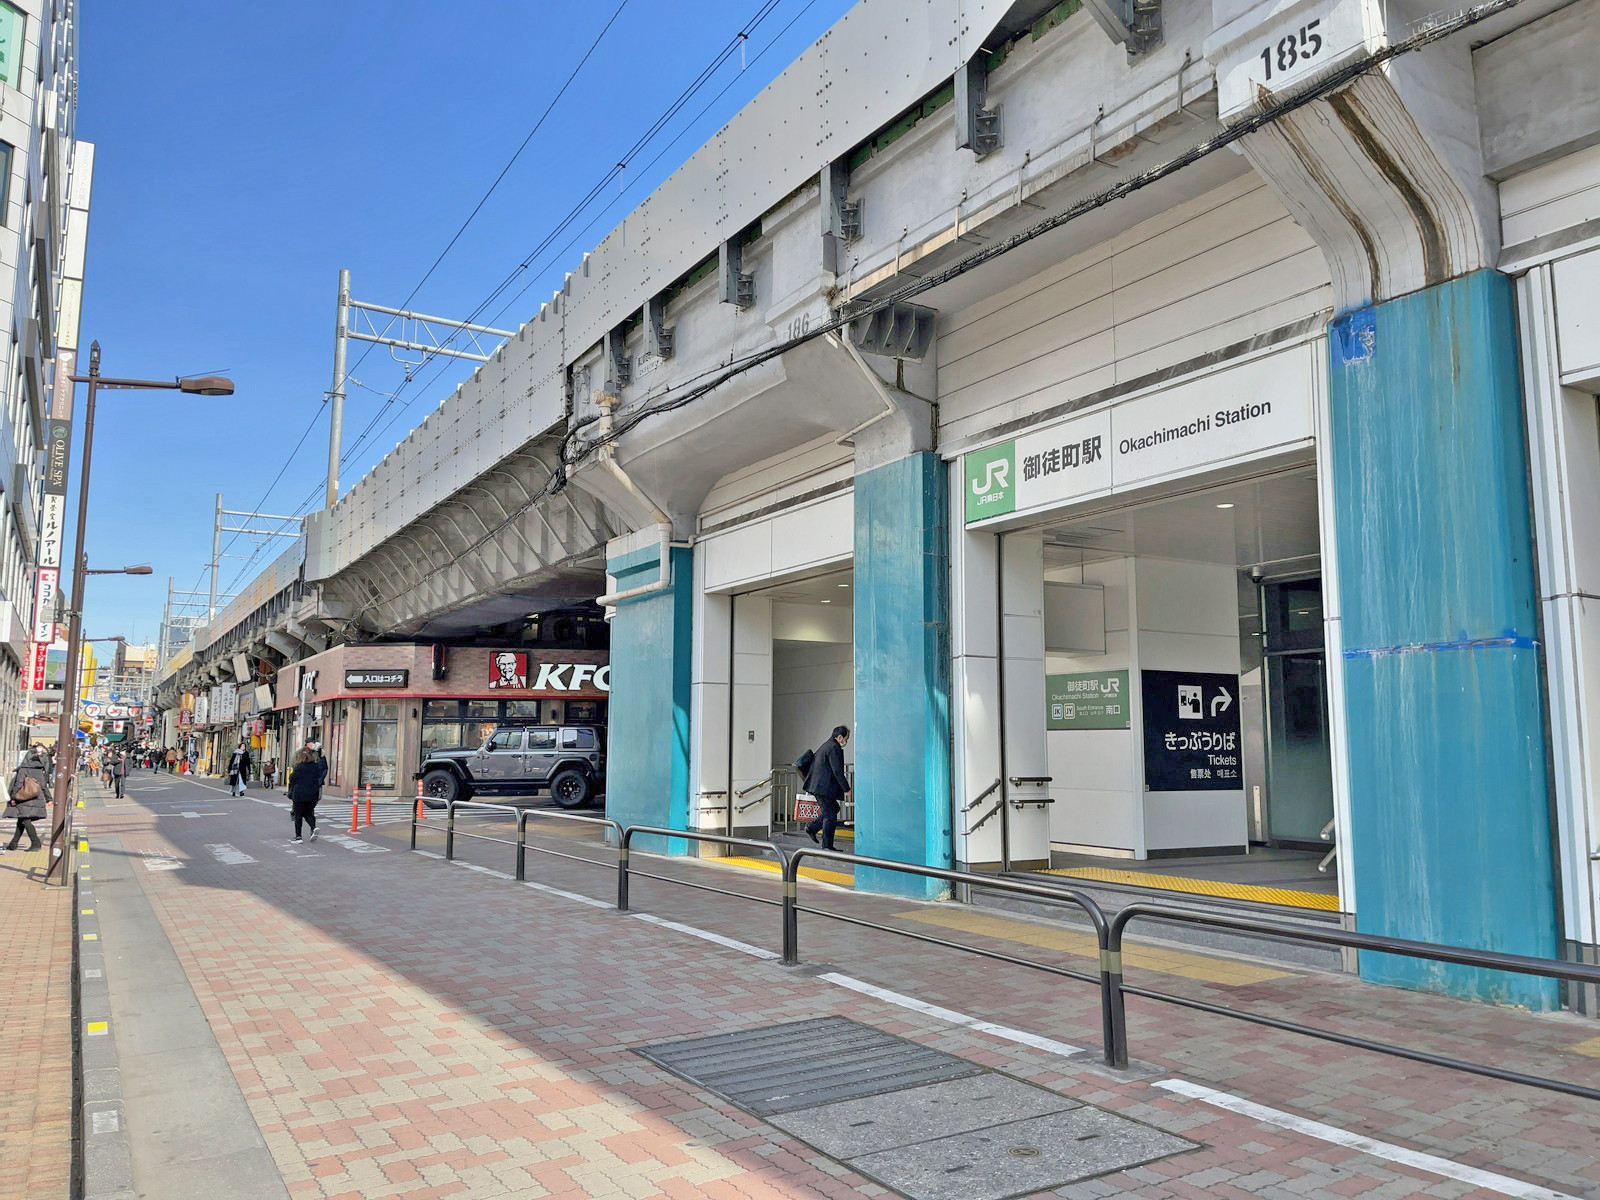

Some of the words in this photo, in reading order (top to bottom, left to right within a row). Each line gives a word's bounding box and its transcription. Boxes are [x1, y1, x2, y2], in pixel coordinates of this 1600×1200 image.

[1261, 18, 1322, 81] 185
[788, 312, 810, 341] 186
[1119, 415, 1211, 455] Okachimachi
[1215, 401, 1272, 428] Station
[55, 439, 65, 468] OLIVE
[1023, 435, 1102, 482] 御徒町駅
[53, 469, 63, 486] SPA
[972, 458, 1009, 495] JR
[976, 491, 1005, 506] JR東日本
[364, 675, 404, 683] 入口はコチラ
[1067, 679, 1099, 692] 御徒町駅
[1101, 678, 1120, 693] JR
[1105, 704, 1120, 715] 南口
[1165, 732, 1236, 750] きっぷうりば
[1208, 754, 1237, 766] Tickets
[1216, 768, 1238, 778] 매표소
